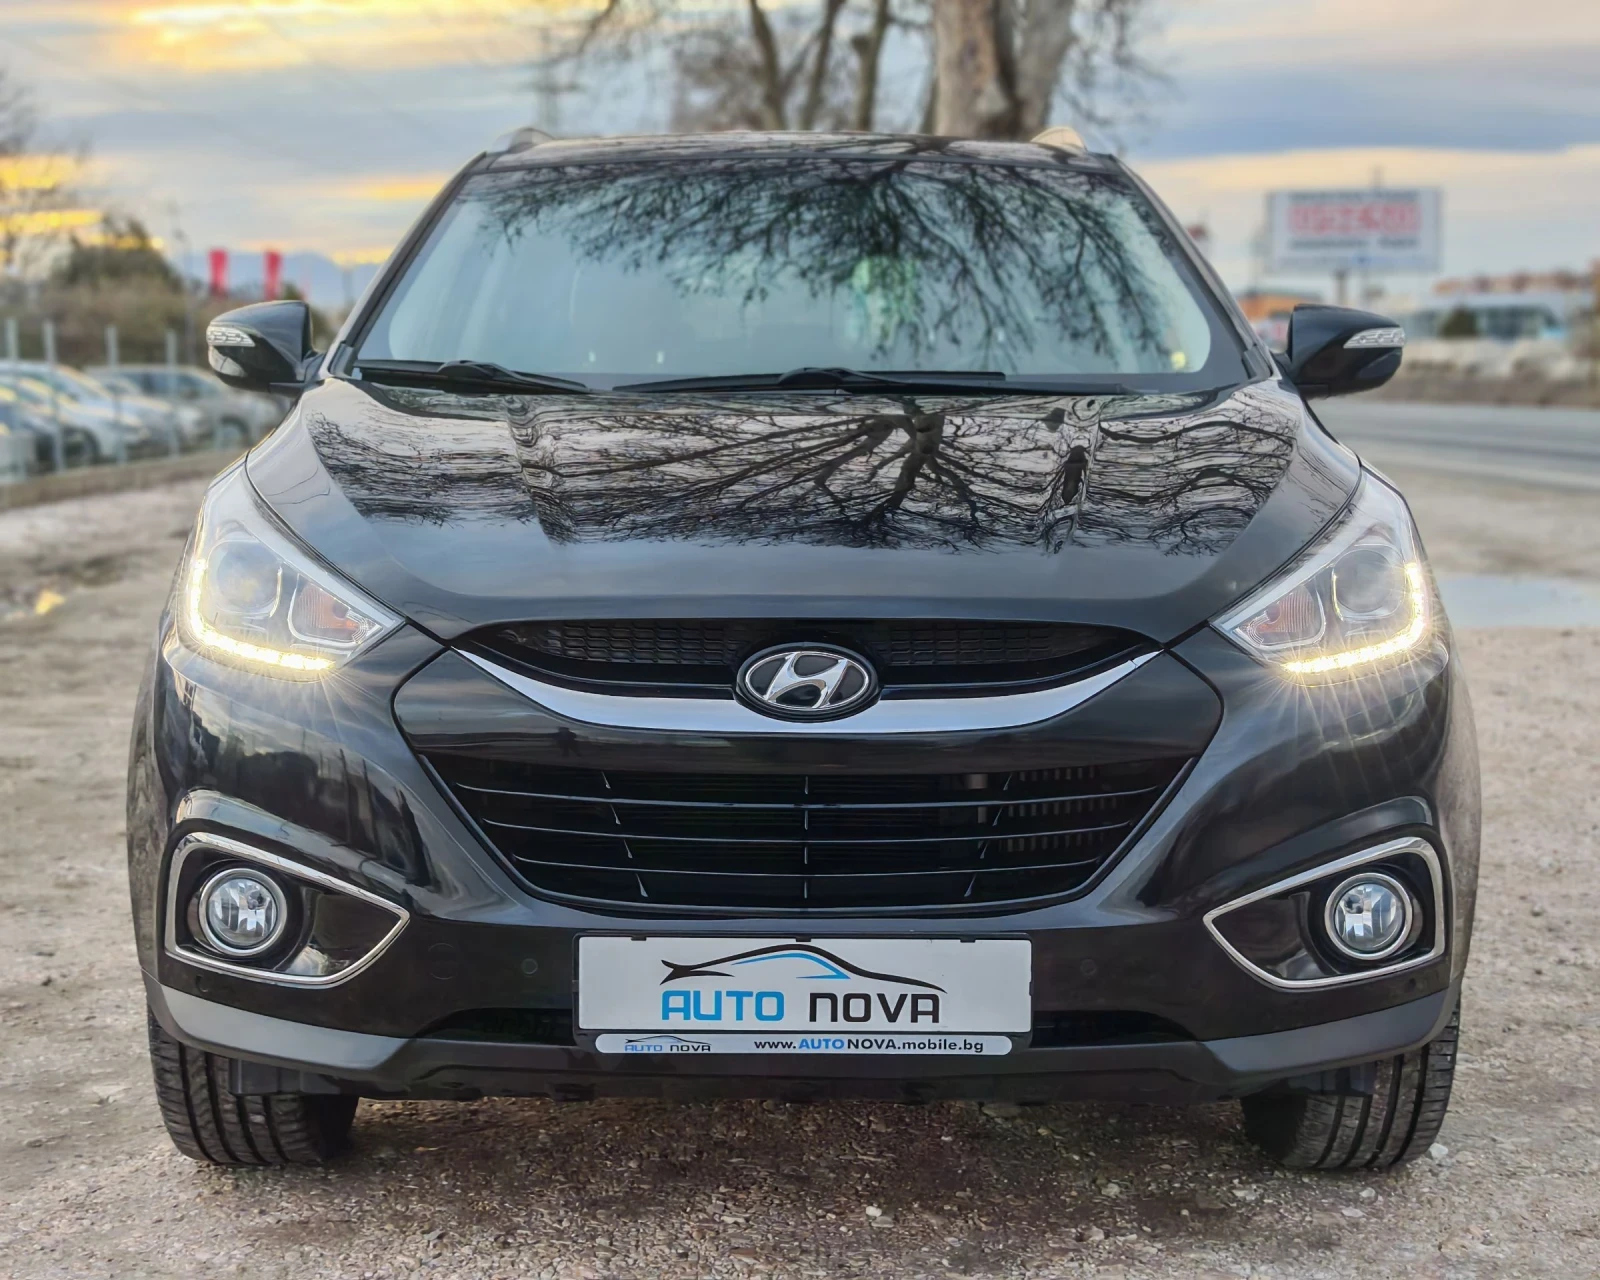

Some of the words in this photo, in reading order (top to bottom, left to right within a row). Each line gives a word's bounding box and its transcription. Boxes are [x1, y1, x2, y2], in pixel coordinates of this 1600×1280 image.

[661, 990, 785, 1021] AUTO
[809, 992, 940, 1023] NOVA
[624, 1044, 663, 1052] AUTO
[670, 1044, 711, 1052] NOVA
